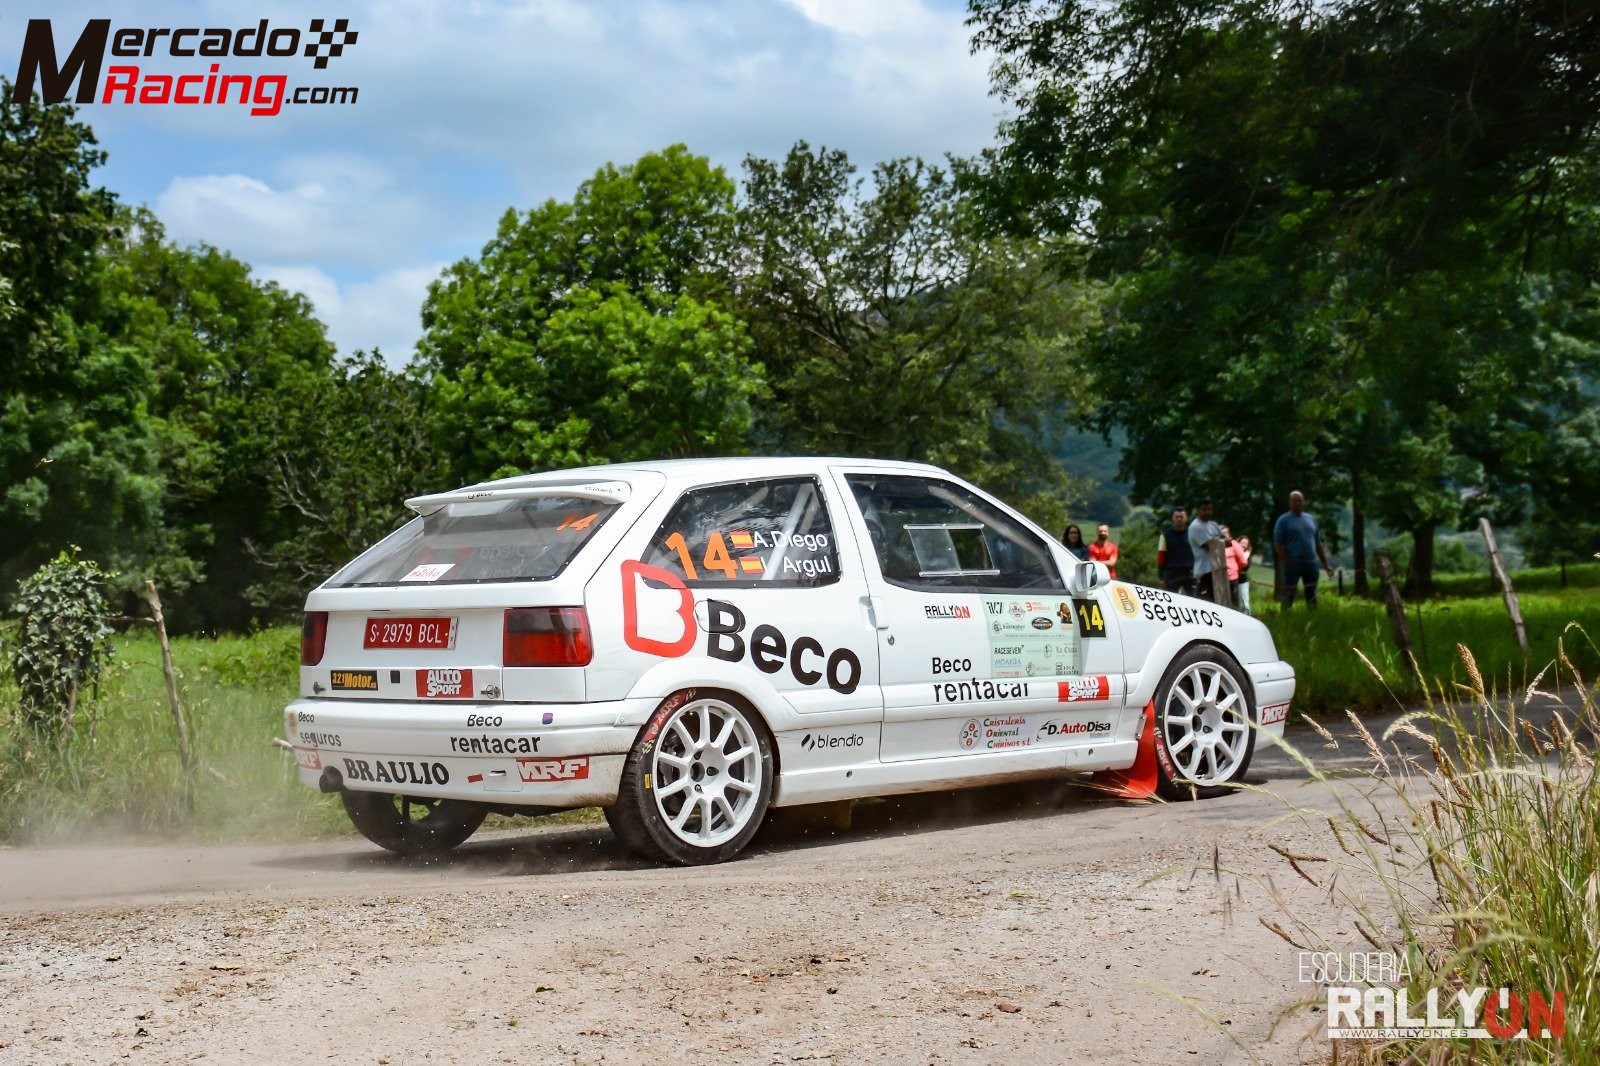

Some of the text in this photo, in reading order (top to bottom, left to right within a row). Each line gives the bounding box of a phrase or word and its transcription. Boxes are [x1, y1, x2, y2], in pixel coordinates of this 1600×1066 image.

[665, 532, 737, 580] 14
[783, 556, 832, 577] Argul
[1134, 586, 1172, 602] Beco
[1079, 604, 1104, 631] 14
[1143, 603, 1223, 627] seguros
[383, 623, 413, 643] 2979
[418, 624, 442, 643] BCL
[706, 597, 862, 695] Beco
[931, 657, 972, 674] Beco
[427, 670, 462, 684] AUTO
[1069, 676, 1099, 690] AUTO
[933, 677, 1029, 702] rentacar
[298, 711, 315, 723] Beco
[467, 714, 503, 727] Beco
[300, 731, 342, 748] seguros
[450, 734, 541, 753] rentacar
[817, 733, 864, 749] blendio
[342, 757, 450, 785] BRAULIO
